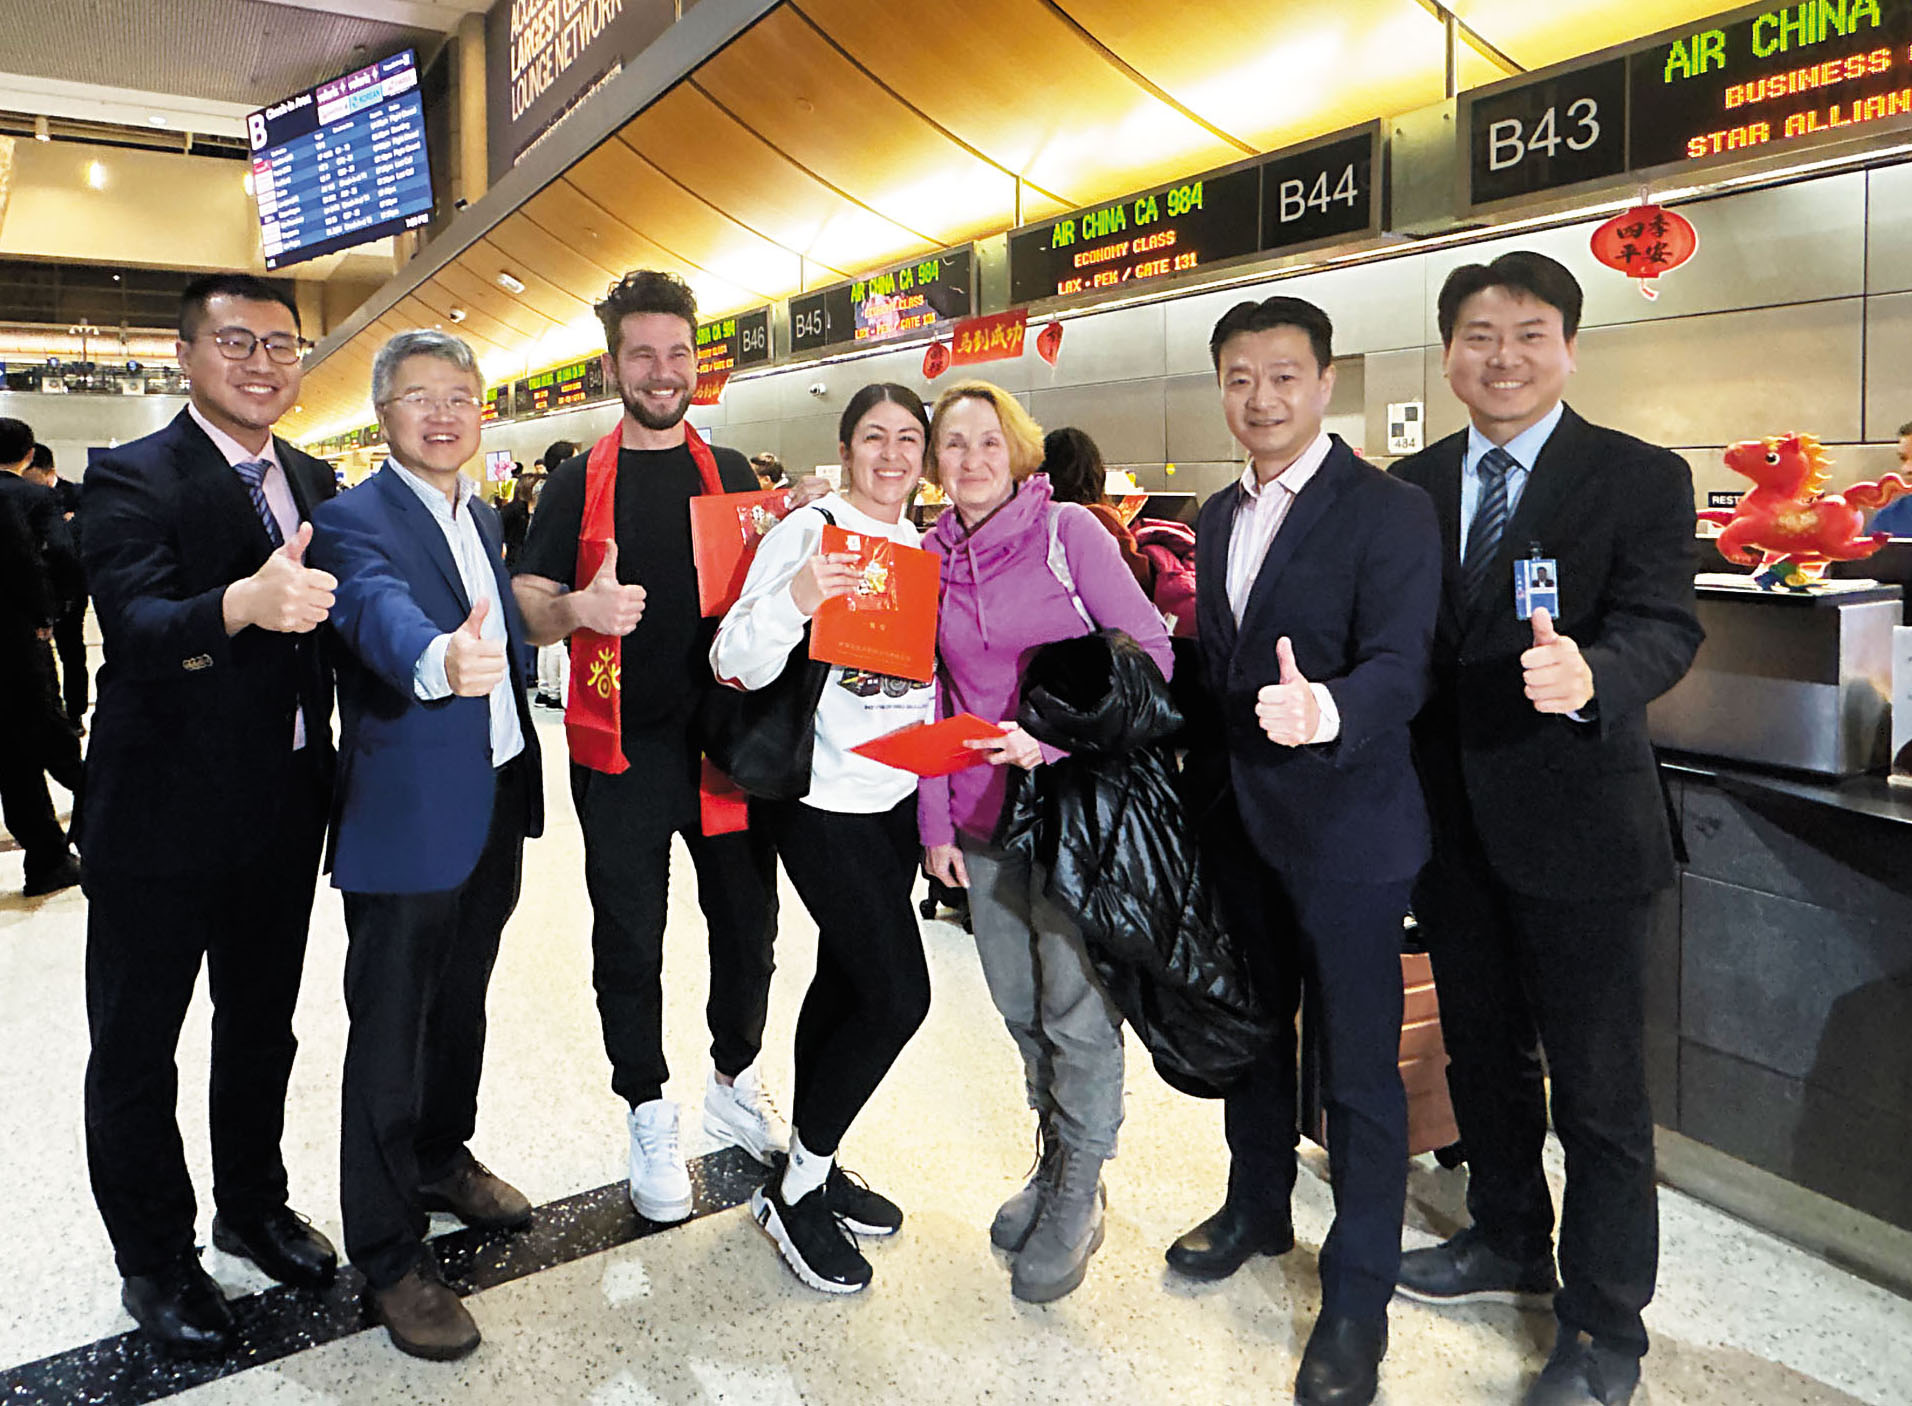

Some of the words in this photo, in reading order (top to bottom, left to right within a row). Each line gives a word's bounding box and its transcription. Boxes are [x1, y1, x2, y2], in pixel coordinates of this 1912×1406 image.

[511, 0, 560, 82] LARGEST
[1664, 29, 1726, 83] AIR
[1752, 0, 1882, 58] CHINA
[512, 44, 554, 121] LOUNGE
[1725, 48, 1892, 109] BUSINESS
[248, 113, 268, 151] B
[1489, 97, 1600, 172] B43
[1687, 121, 1770, 158] STAR
[1785, 88, 1912, 138] ALLIAN
[1052, 219, 1076, 249] AIR
[1082, 205, 1126, 240] CHINA
[1134, 195, 1159, 226] CA
[1167, 181, 1204, 217] 984
[1279, 163, 1358, 223] B44
[1057, 278, 1082, 296] LAX
[1094, 269, 1118, 288] PEK
[1122, 267, 1131, 282] /
[1135, 258, 1170, 279] GATE
[1174, 252, 1198, 270] 131
[1074, 241, 1130, 268] ECONOMY
[1133, 230, 1177, 253] CLASS
[851, 282, 865, 303] AIR
[869, 272, 895, 296] CHINA
[899, 268, 914, 290] CA
[917, 260, 939, 285] 984
[743, 326, 765, 352] B46
[796, 310, 822, 338] B45
[958, 320, 1024, 353] 马到成功
